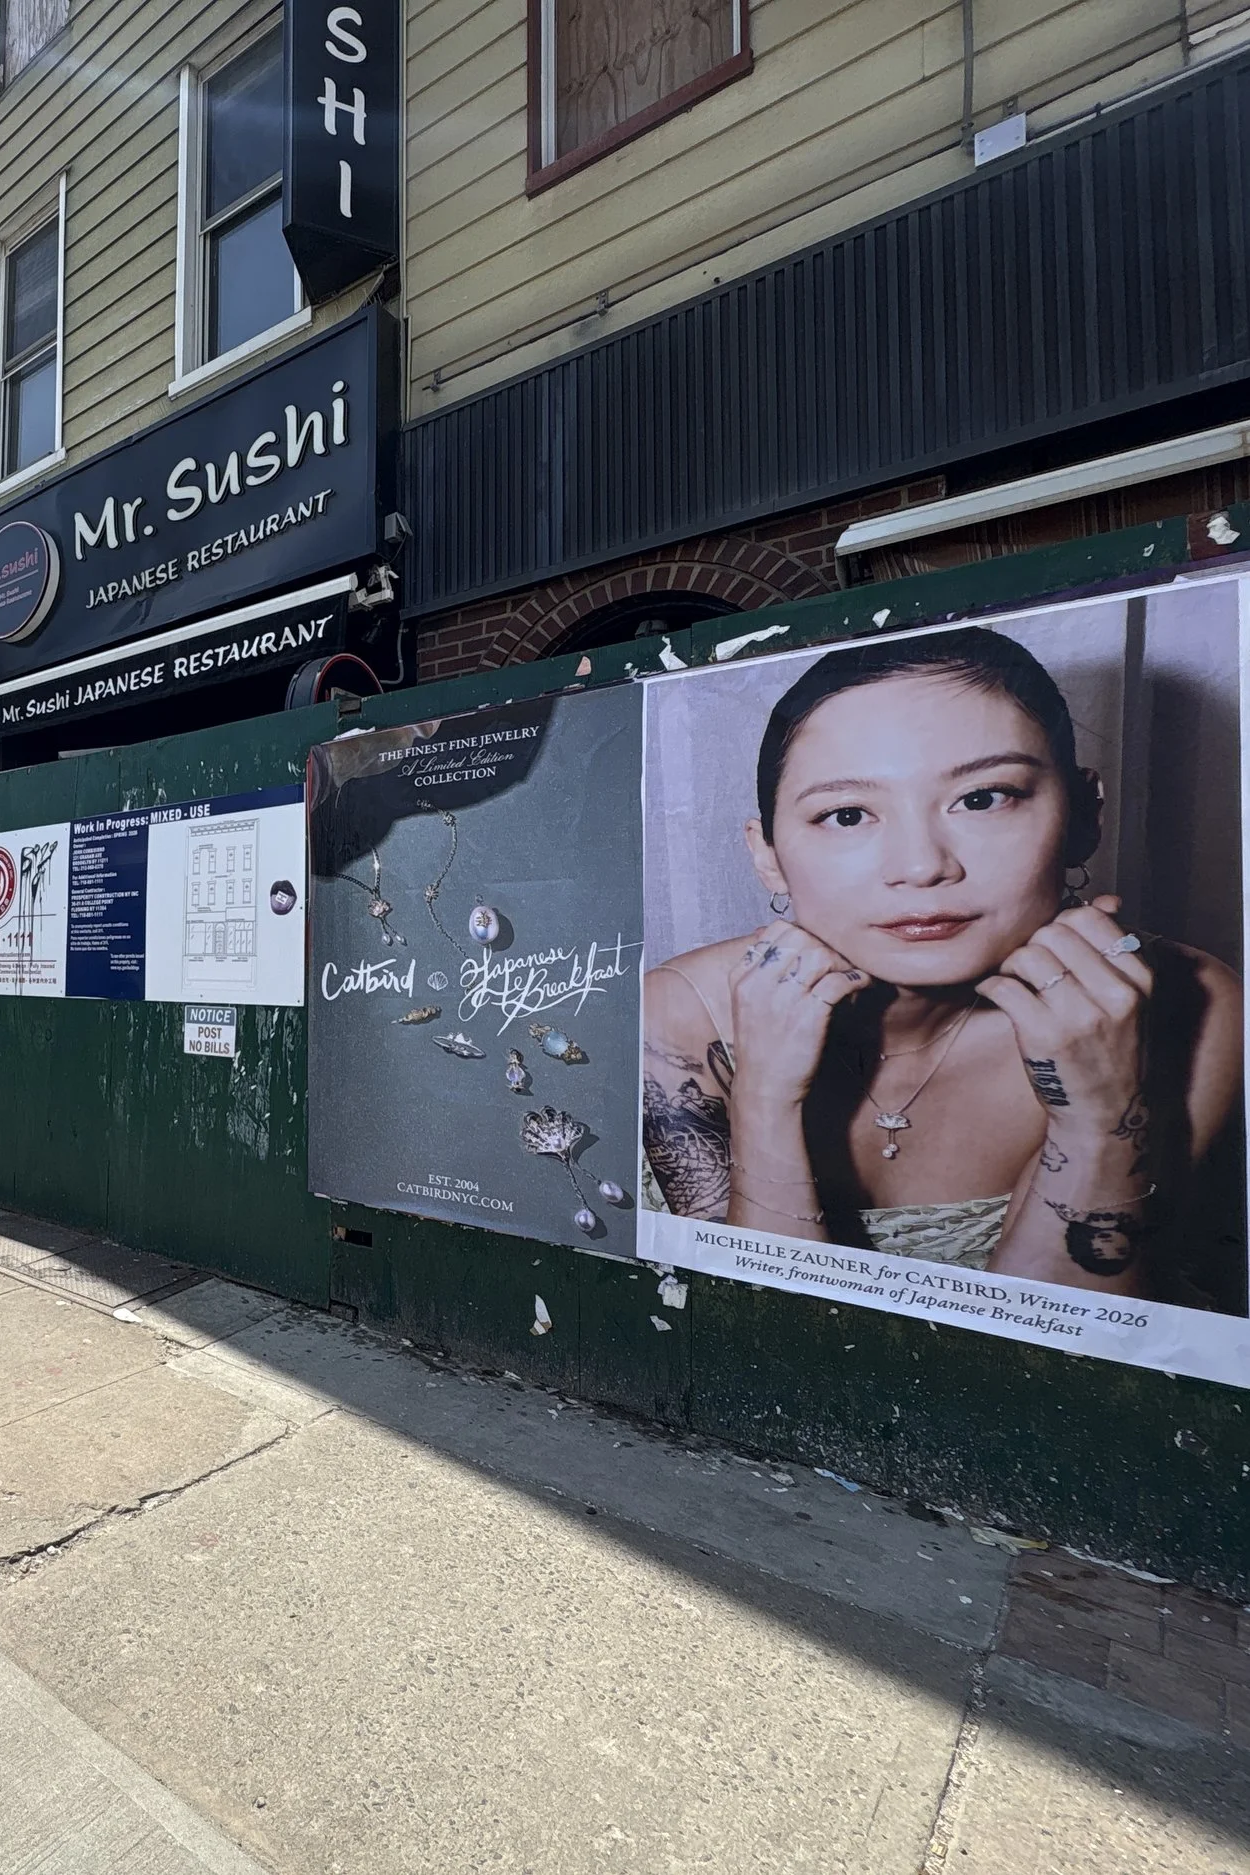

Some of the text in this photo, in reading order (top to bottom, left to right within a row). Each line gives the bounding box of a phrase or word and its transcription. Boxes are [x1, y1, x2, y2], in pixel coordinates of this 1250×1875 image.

[317, 6, 367, 218] SHI
[74, 380, 347, 561] Mr. Sushi
[86, 488, 334, 610] JAPANESE RESTAURANT
[2, 705, 24, 724] Mr.
[26, 690, 70, 718] Sushi
[73, 663, 165, 706] JAPANESE
[174, 614, 334, 679] RESTAURANT
[378, 726, 540, 762] THE FINEST FINE JEWELRY
[414, 766, 497, 787] COLLECTION
[417, 755, 467, 774] Limited
[467, 749, 515, 767] Edition
[73, 823, 94, 834] Work
[96, 822, 105, 832] In
[106, 816, 149, 831] Progress:
[150, 808, 182, 823] MIXED
[189, 804, 211, 818] USE
[321, 958, 417, 1001] Catbird
[190, 1008, 232, 1023] NOTICE
[189, 1039, 230, 1054] NO BILLS
[197, 1026, 222, 1039] POST
[396, 1182, 514, 1212] CATBIRDNYC.COM
[428, 1174, 479, 1192] EST. 2004
[695, 1231, 1150, 1328] MICHELLE ZAUNER for CATBIRD, Winter 2026
[735, 1255, 1084, 1337] Writer, frontwoman of Japanese Breakfast
